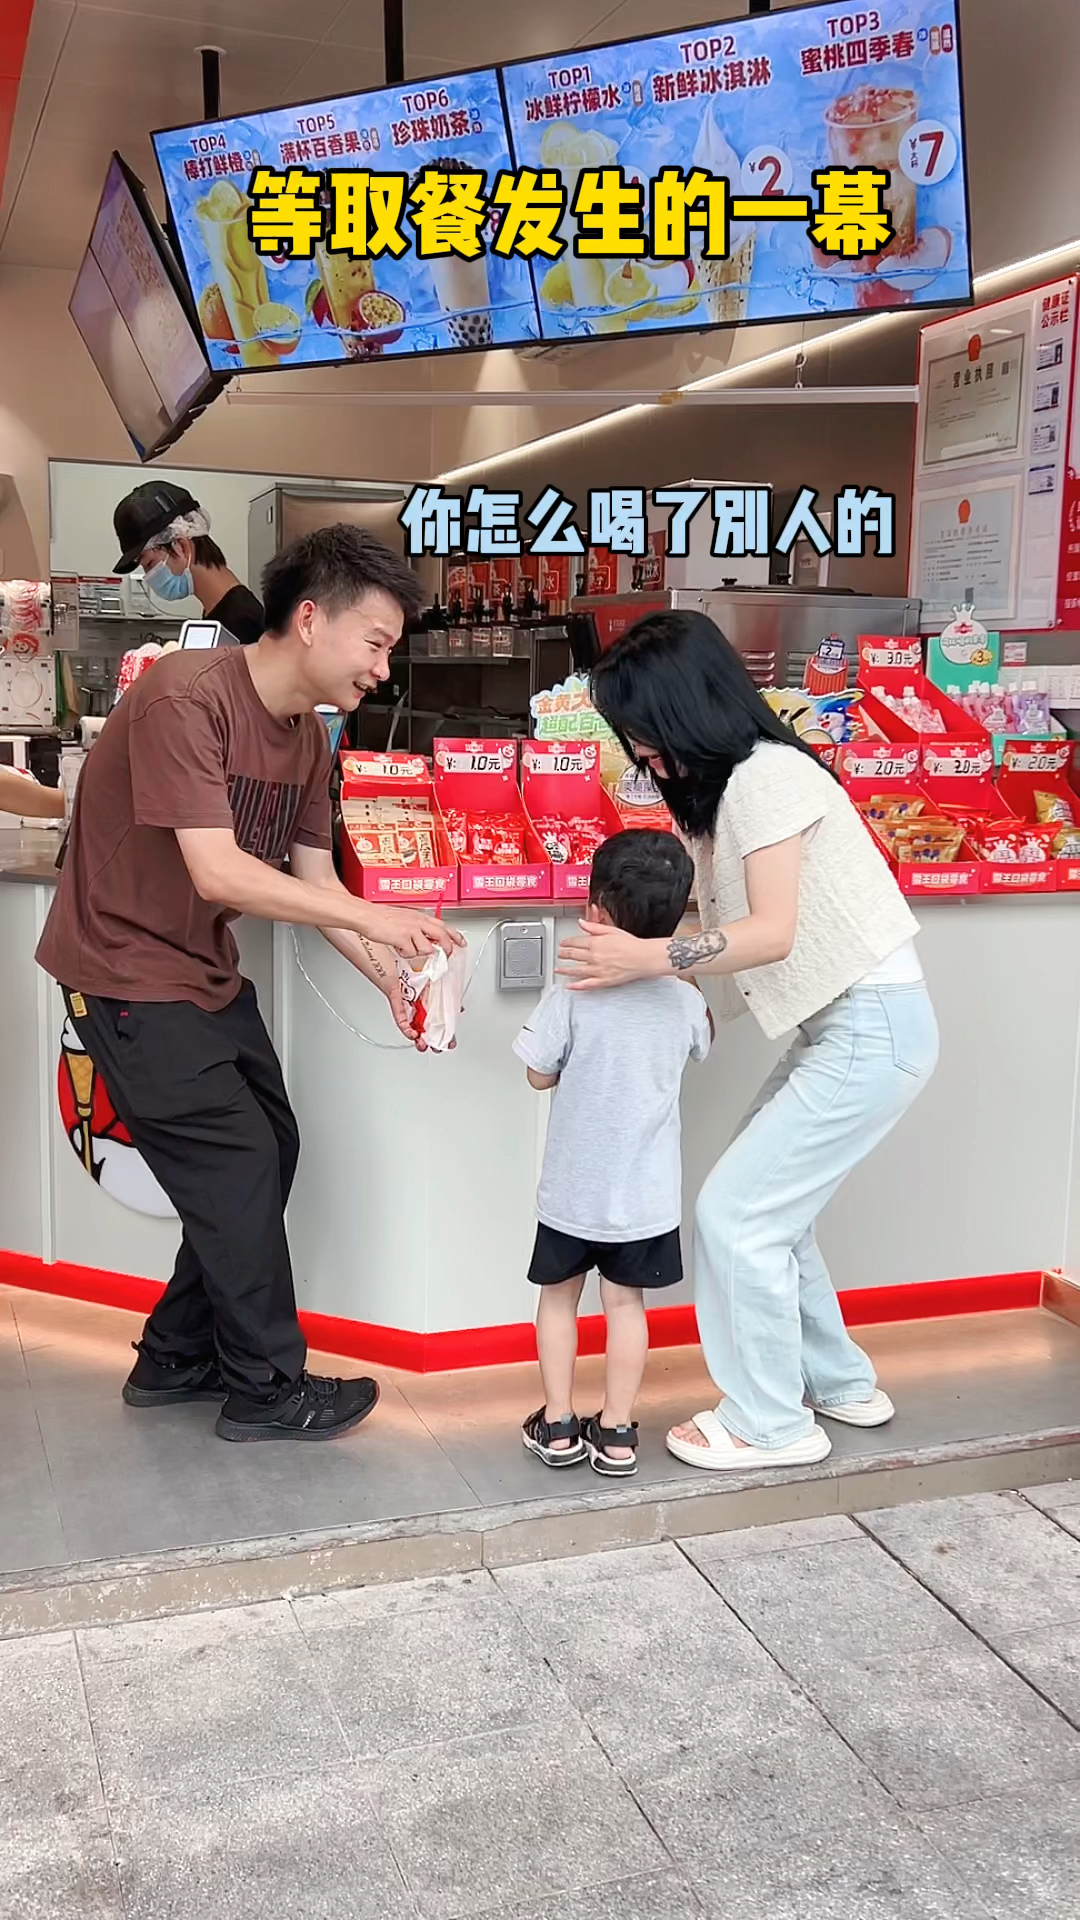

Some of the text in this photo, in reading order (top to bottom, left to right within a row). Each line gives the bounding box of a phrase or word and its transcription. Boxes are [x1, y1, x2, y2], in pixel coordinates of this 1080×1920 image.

[827, 12, 880, 38] TOP3
[680, 36, 736, 64] TOP2
[801, 31, 914, 76] 蜜桃四季春
[548, 66, 592, 88] TOP1
[652, 57, 771, 102] 新鲜冰淇淋
[403, 89, 449, 114] TOP6
[525, 85, 621, 120] 冰鲜柠檬水
[297, 115, 335, 134] TOP5
[391, 112, 470, 146] 珍珠奶茶
[190, 135, 227, 153] TOP4
[280, 131, 361, 164] 满杯百香果
[183, 154, 244, 181] 棒打鲜橙
[1042, 290, 1070, 312] 健康证
[1041, 309, 1070, 328] 公示栏
